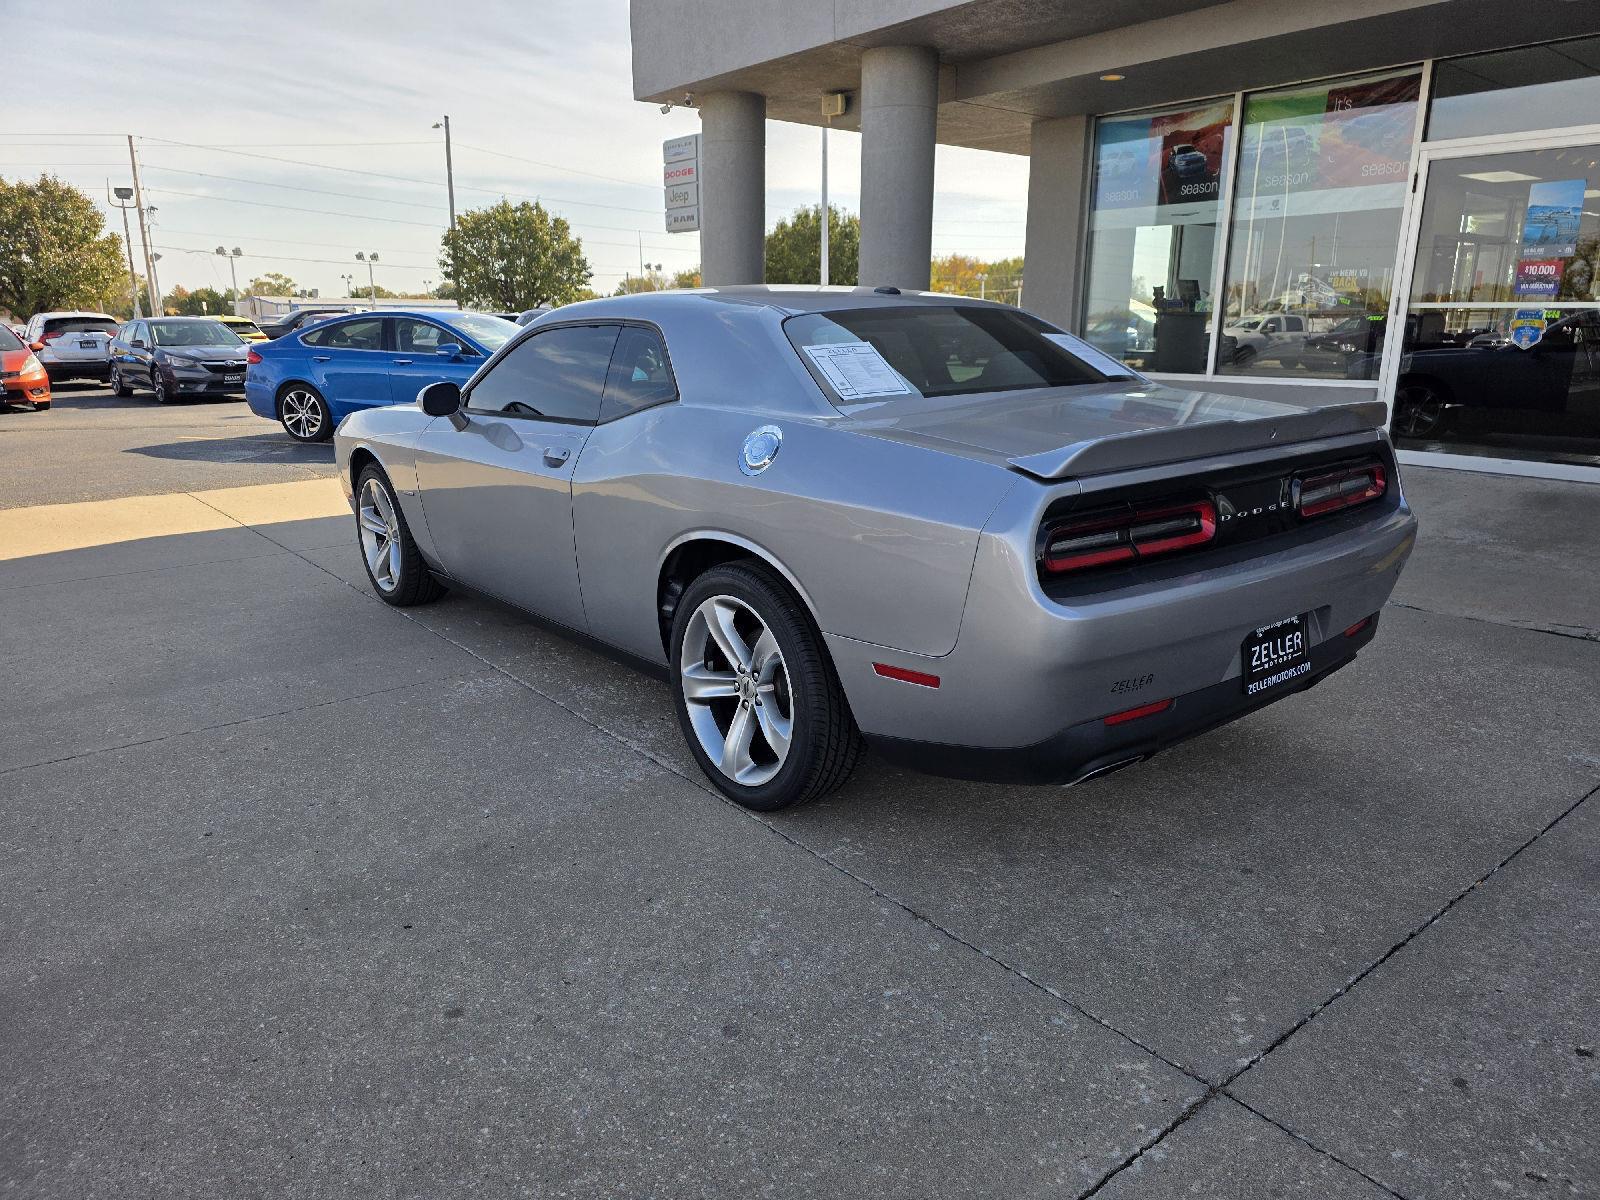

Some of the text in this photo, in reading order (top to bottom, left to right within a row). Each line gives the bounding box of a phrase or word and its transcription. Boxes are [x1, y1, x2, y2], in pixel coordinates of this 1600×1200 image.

[665, 168, 694, 179] DODGE
[669, 188, 689, 204] Jeep
[673, 215, 695, 223] RAM
[1221, 501, 1289, 521] DODGE
[1252, 631, 1302, 667] ZELLER
[1264, 653, 1292, 669] MOTORS
[1110, 673, 1154, 693] ZELLER
[1247, 661, 1311, 695] ZELLERMOTORS.COM
